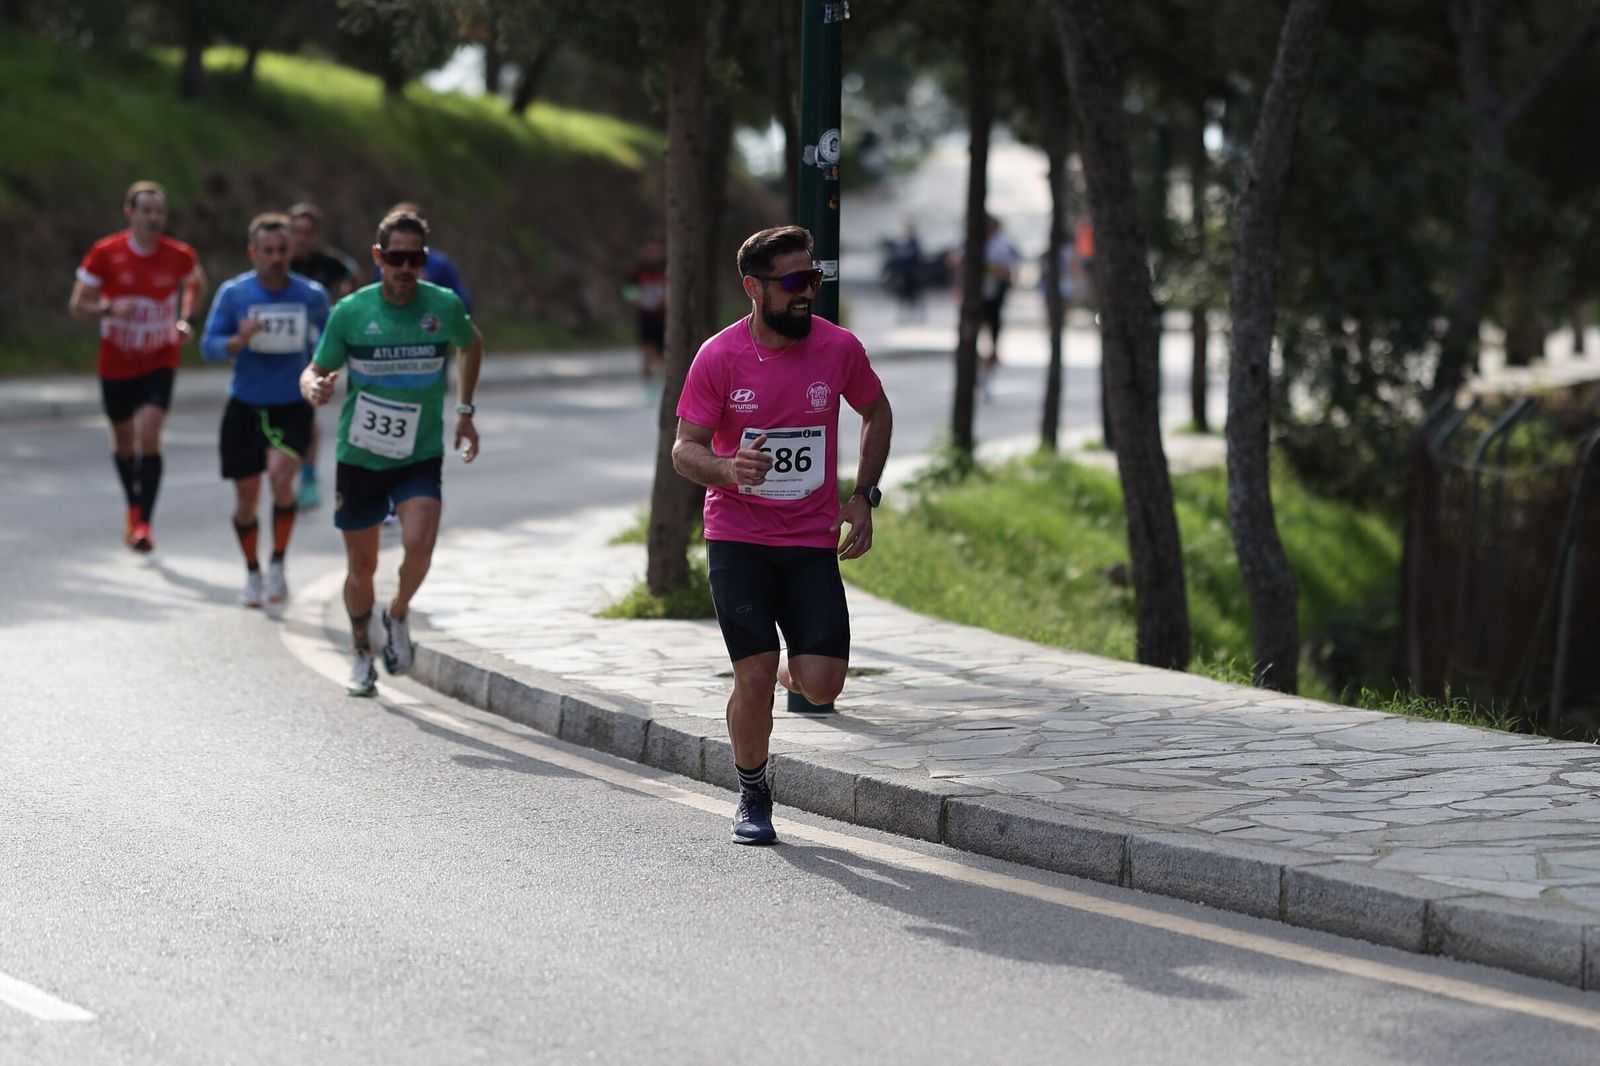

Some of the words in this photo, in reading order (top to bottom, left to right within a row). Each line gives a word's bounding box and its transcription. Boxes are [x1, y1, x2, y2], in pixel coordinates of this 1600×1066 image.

[373, 345, 436, 359] ATLETISMO
[363, 410, 407, 438] 333
[760, 446, 812, 473] 86
